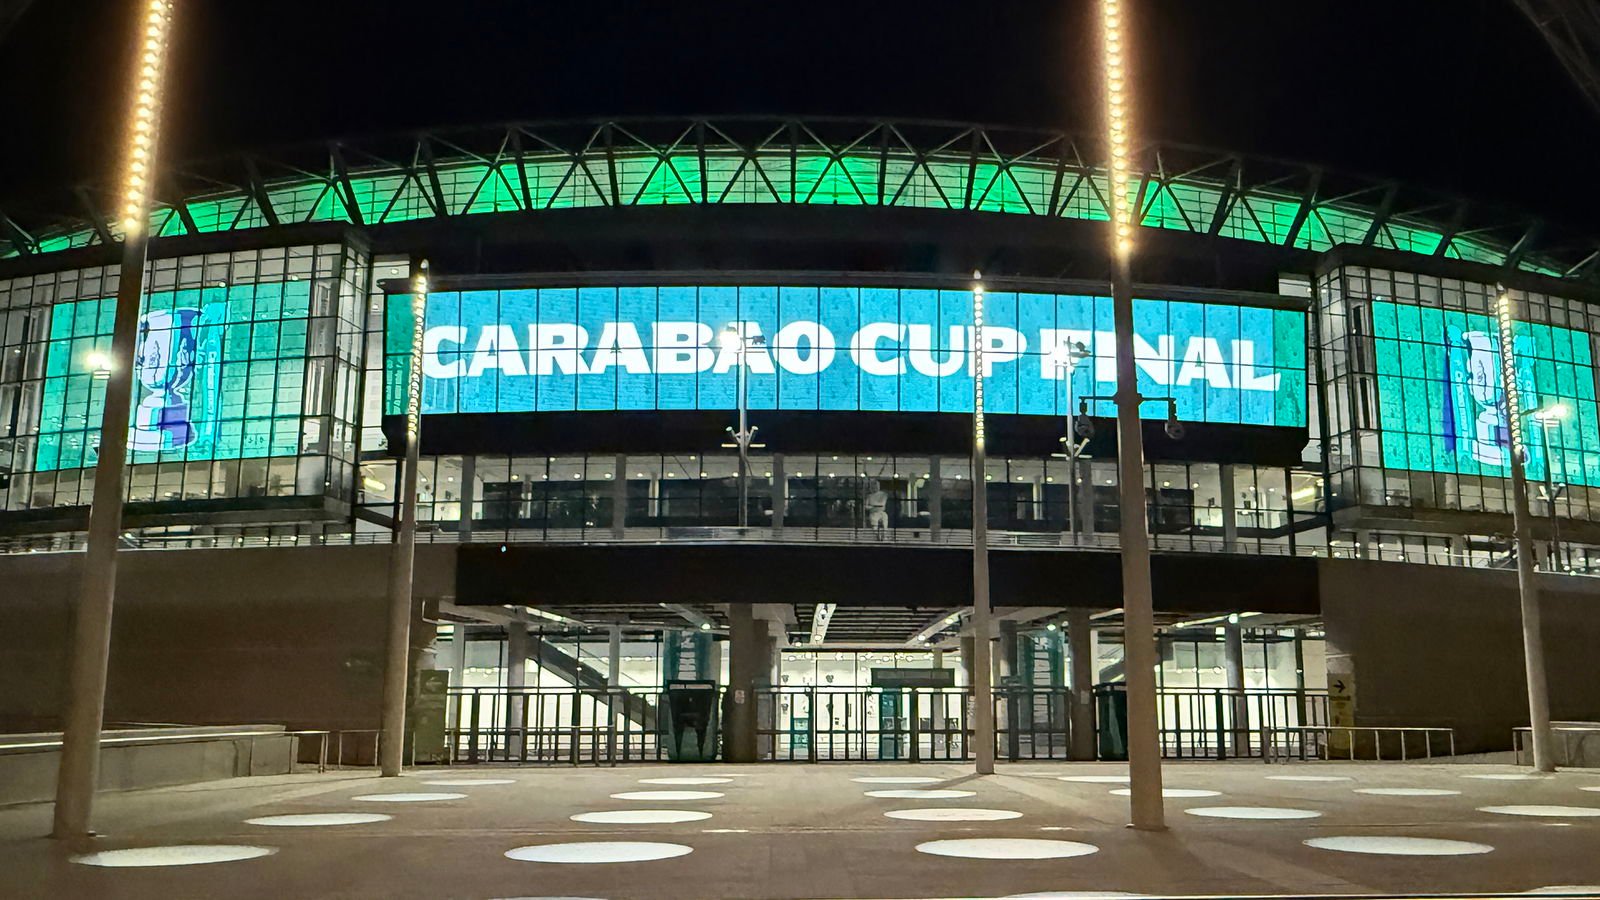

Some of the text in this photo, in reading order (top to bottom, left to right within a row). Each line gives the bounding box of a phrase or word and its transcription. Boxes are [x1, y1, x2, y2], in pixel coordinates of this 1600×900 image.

[423, 320, 1281, 392] CARABAO CUP FINAL
